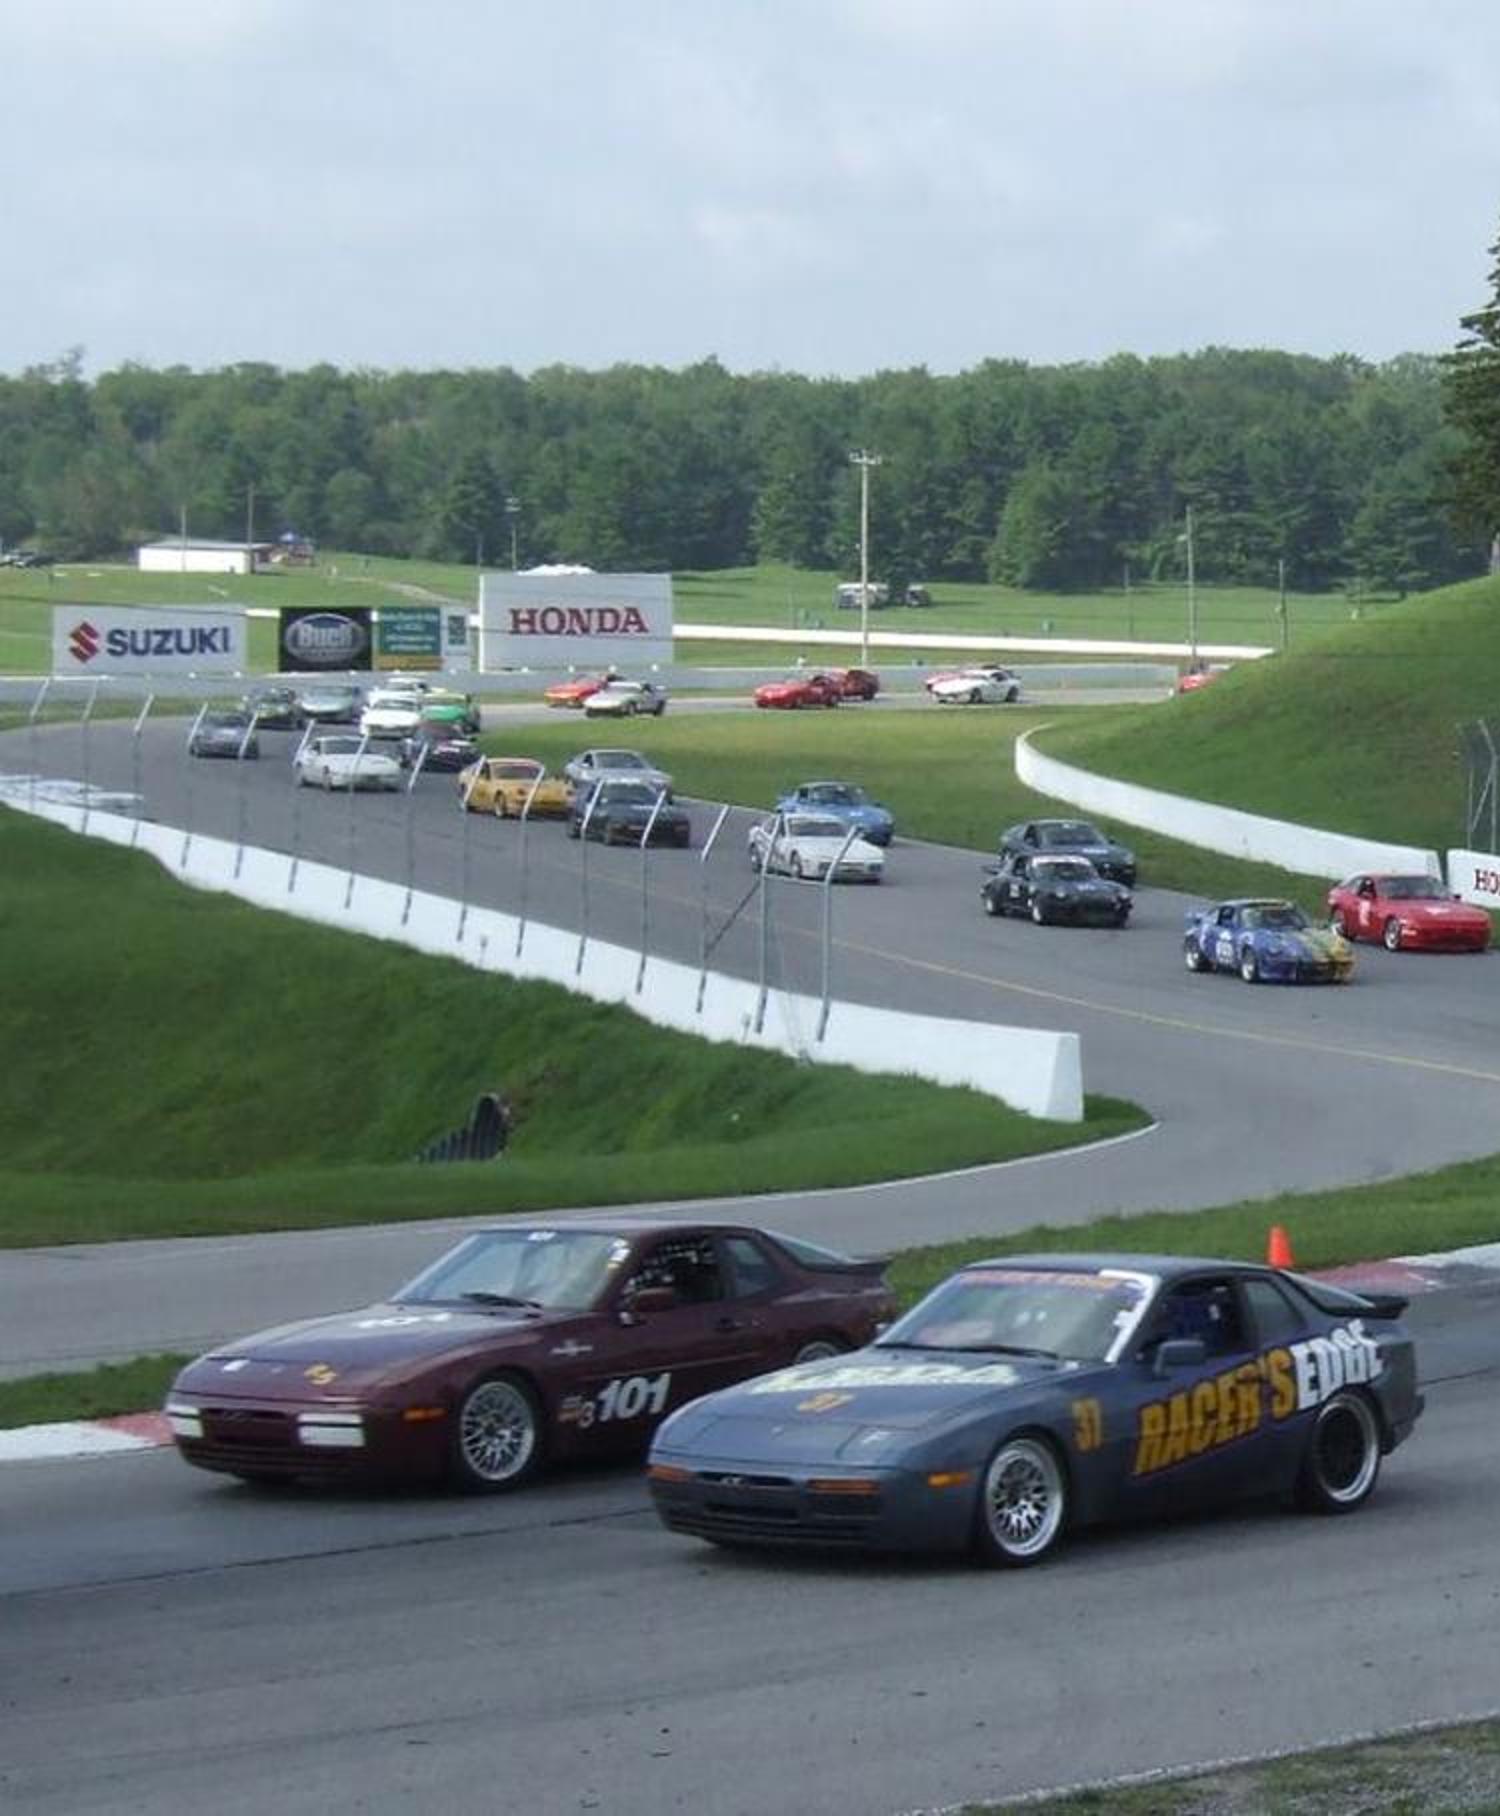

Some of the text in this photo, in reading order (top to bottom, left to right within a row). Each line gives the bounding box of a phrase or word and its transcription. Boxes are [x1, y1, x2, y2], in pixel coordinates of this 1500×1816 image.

[509, 606, 649, 636] HONDA
[106, 626, 231, 657] SUZUKI
[598, 1373, 672, 1422] 101
[1133, 1318, 1383, 1475] RACER'S EDGE
